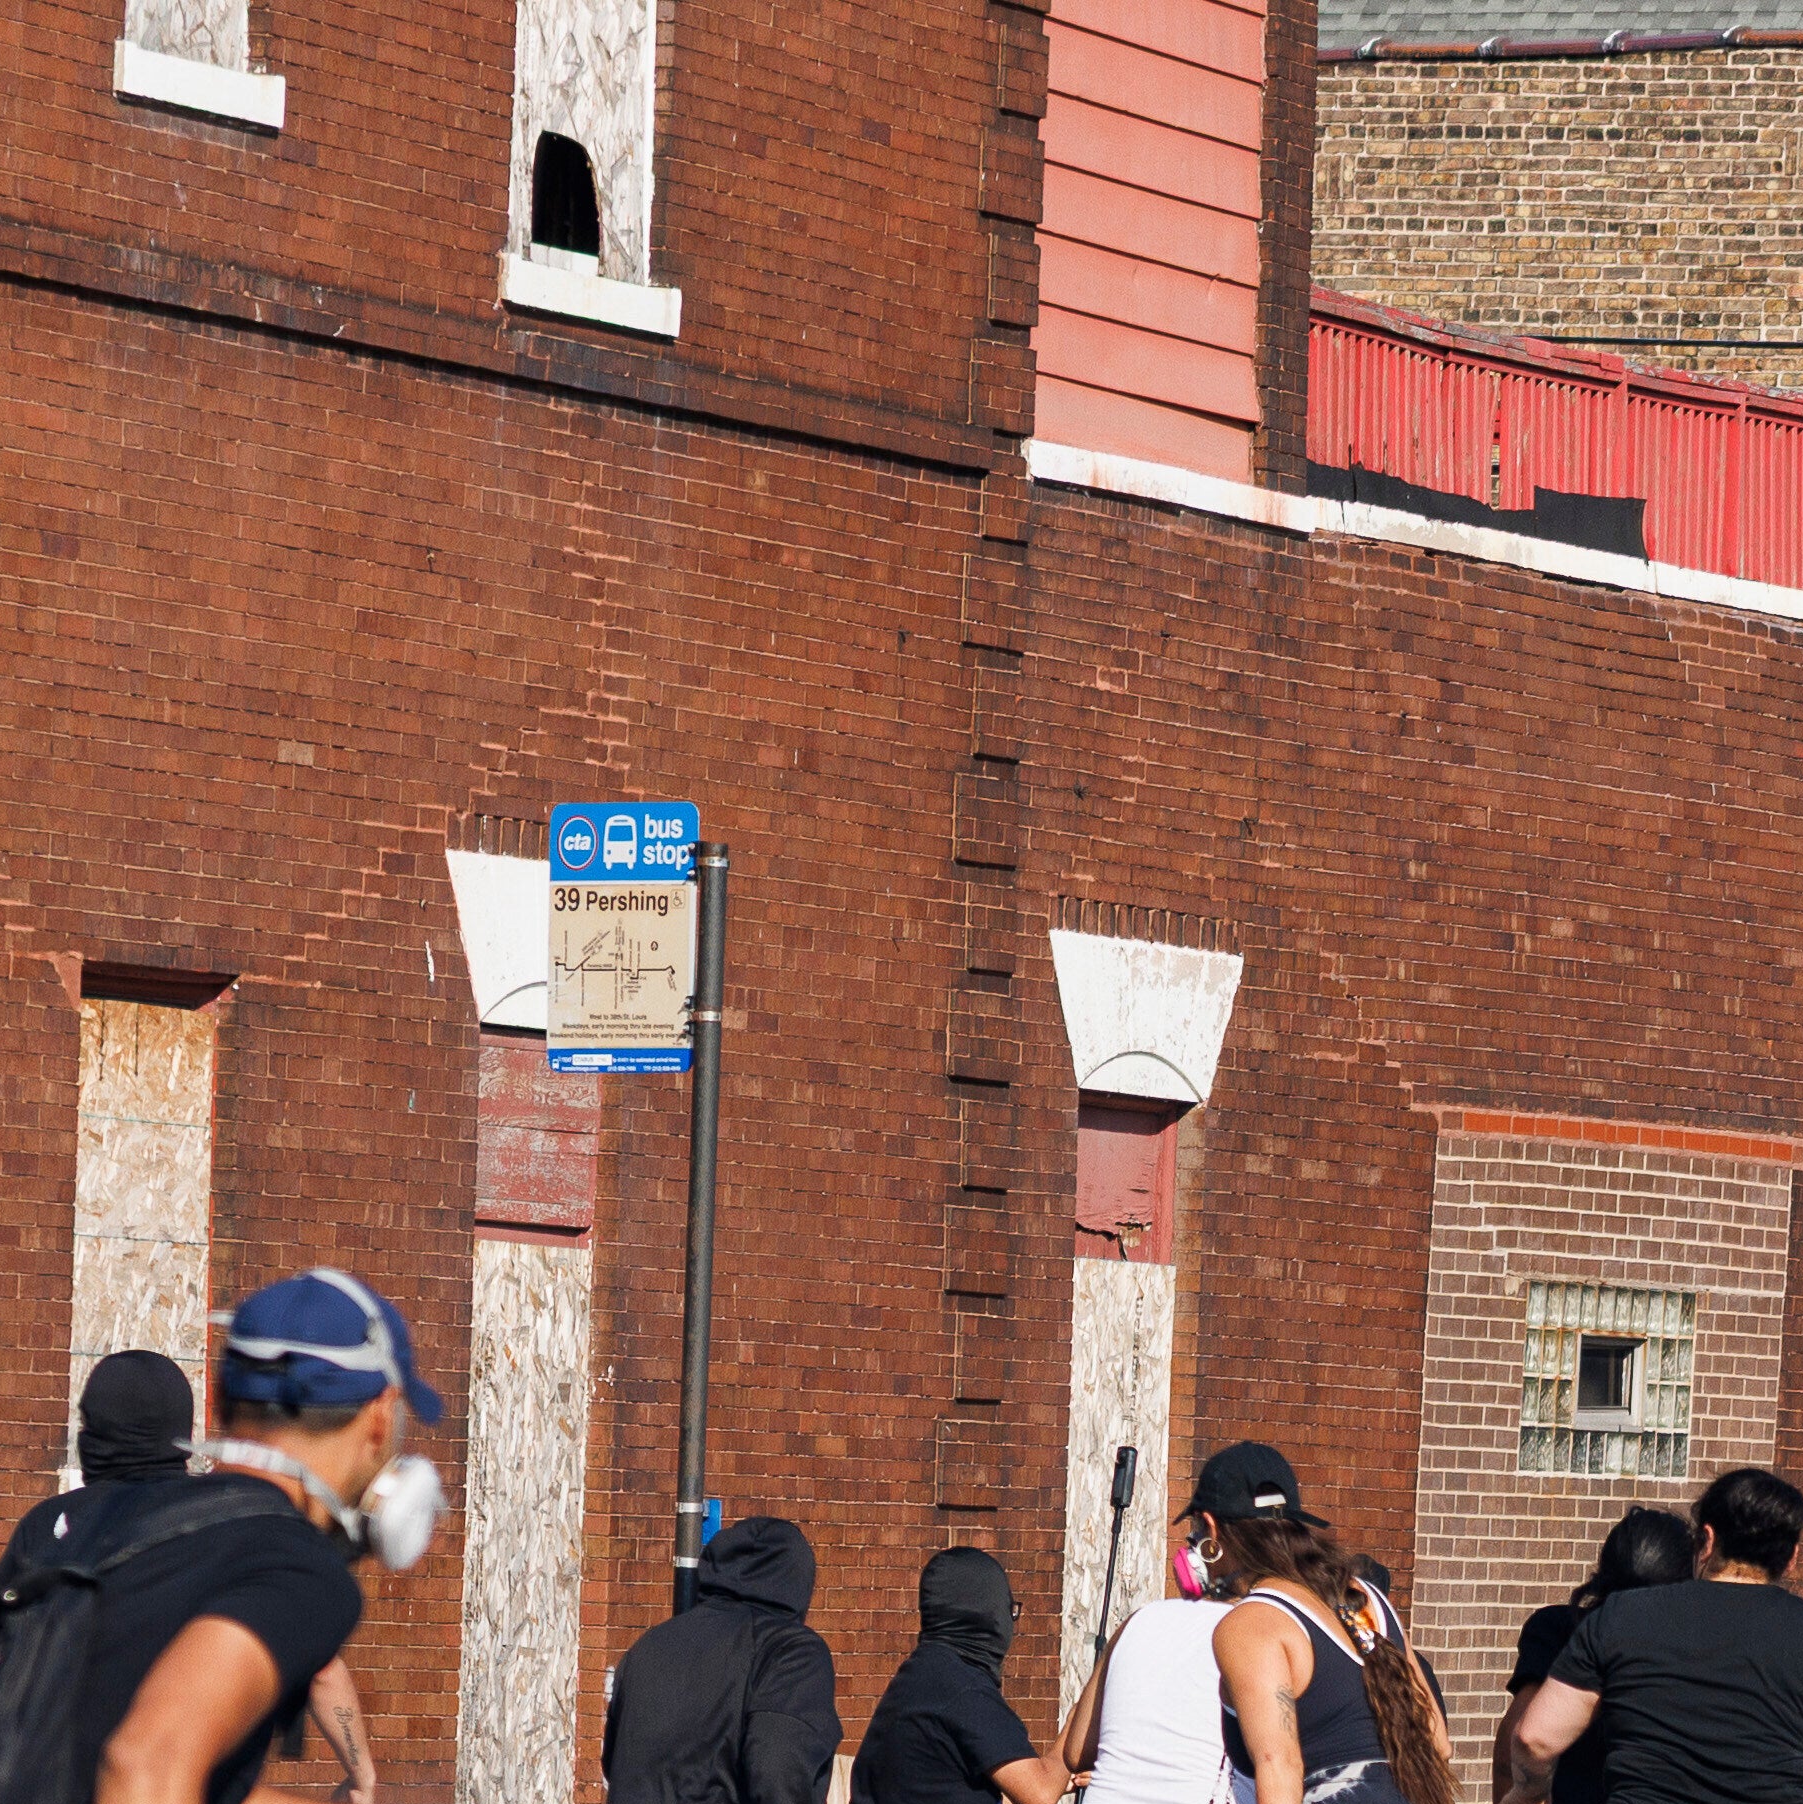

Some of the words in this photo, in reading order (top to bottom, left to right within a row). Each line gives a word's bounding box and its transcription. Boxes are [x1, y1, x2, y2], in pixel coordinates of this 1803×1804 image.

[644, 813, 684, 839] bus
[563, 833, 592, 851] cta
[642, 841, 690, 871] stop
[554, 887, 581, 912] 39
[586, 890, 669, 917] Pershing
